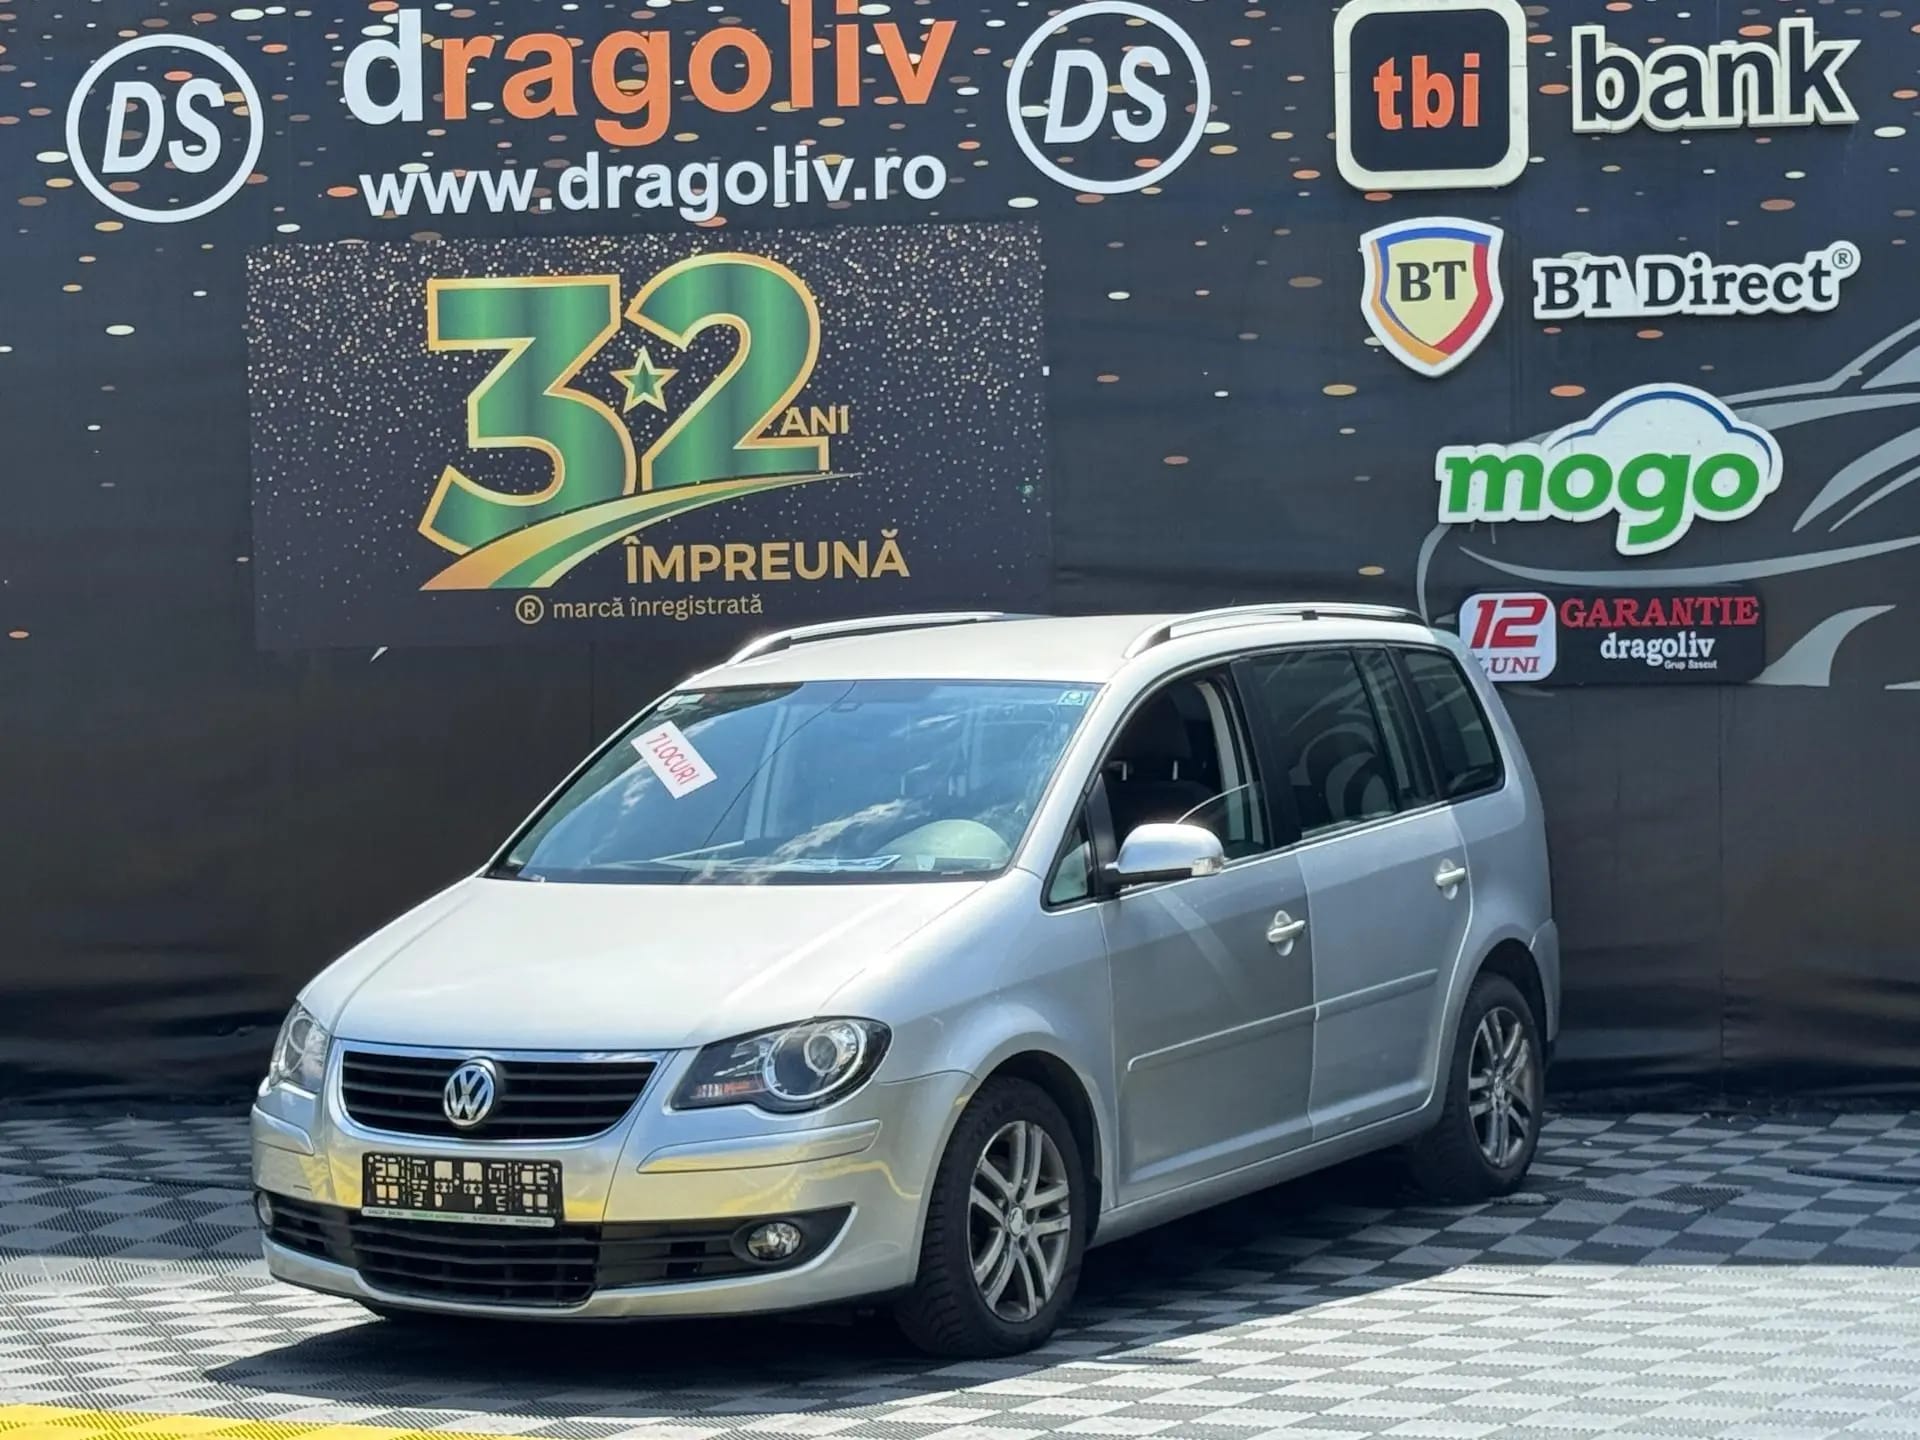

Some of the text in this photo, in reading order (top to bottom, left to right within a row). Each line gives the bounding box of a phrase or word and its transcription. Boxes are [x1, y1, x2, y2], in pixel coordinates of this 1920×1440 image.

[342, 0, 957, 147] dragoliv
[1043, 46, 1172, 144] DS
[1373, 53, 1481, 130] tbi
[1578, 24, 1848, 124] bank
[102, 78, 226, 174] DS
[359, 145, 947, 222] www.dragoliv.ro
[1396, 260, 1468, 302] BT
[1540, 262, 1622, 311] BT
[418, 252, 830, 555] 32
[780, 405, 850, 435] ANI
[1444, 452, 1760, 546] mogo
[625, 529, 910, 584] ÎMPREUNĂ
[553, 597, 625, 619] marcă
[630, 593, 764, 621] înregistrată
[1469, 599, 1549, 649] 12
[1560, 595, 1760, 629] GARANTIE
[1478, 656, 1541, 674] UNI
[1600, 630, 1716, 667] dragoliv
